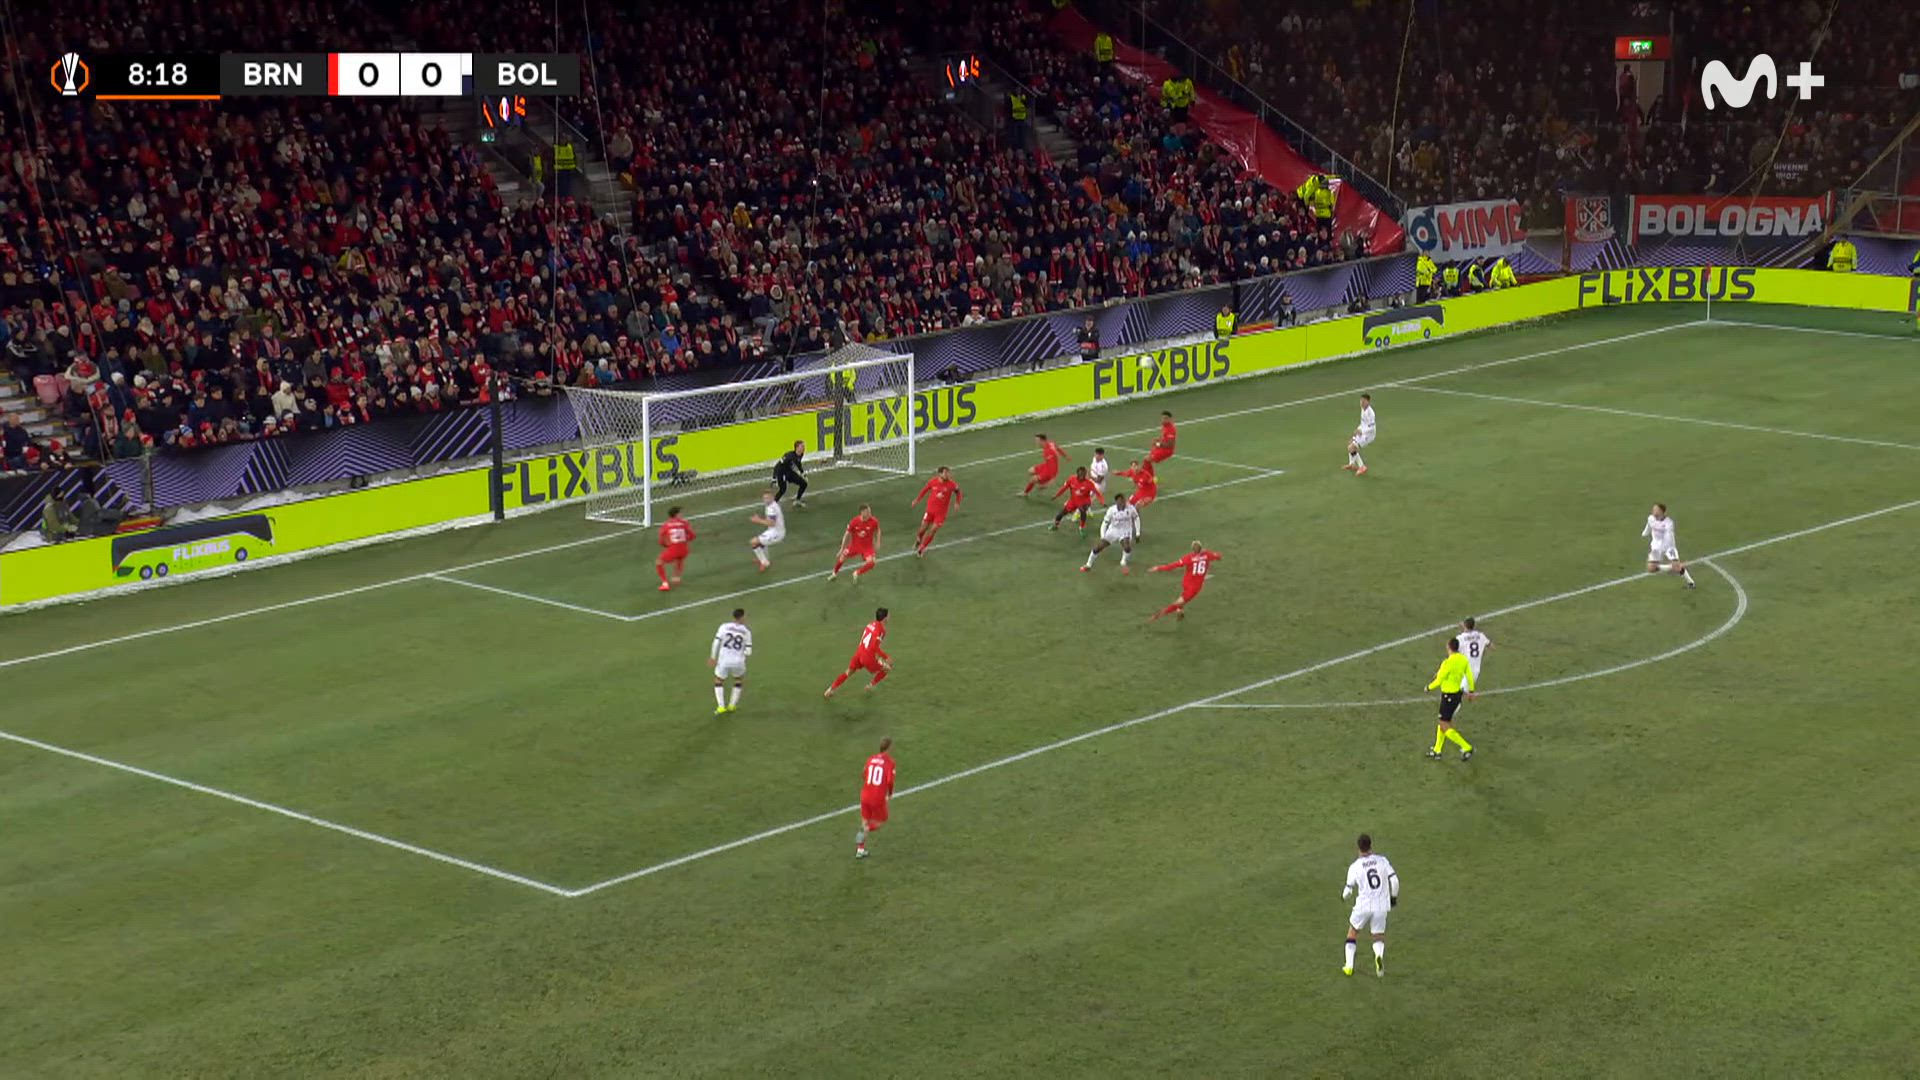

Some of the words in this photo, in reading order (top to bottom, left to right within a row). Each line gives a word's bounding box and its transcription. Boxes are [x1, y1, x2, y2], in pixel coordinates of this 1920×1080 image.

[1638, 204, 1823, 236] BOLOGNA
[1192, 560, 1206, 576] 16
[723, 632, 744, 651] 28
[1470, 641, 1480, 658] 8
[867, 765, 884, 786] 10
[1366, 868, 1381, 890] 6
